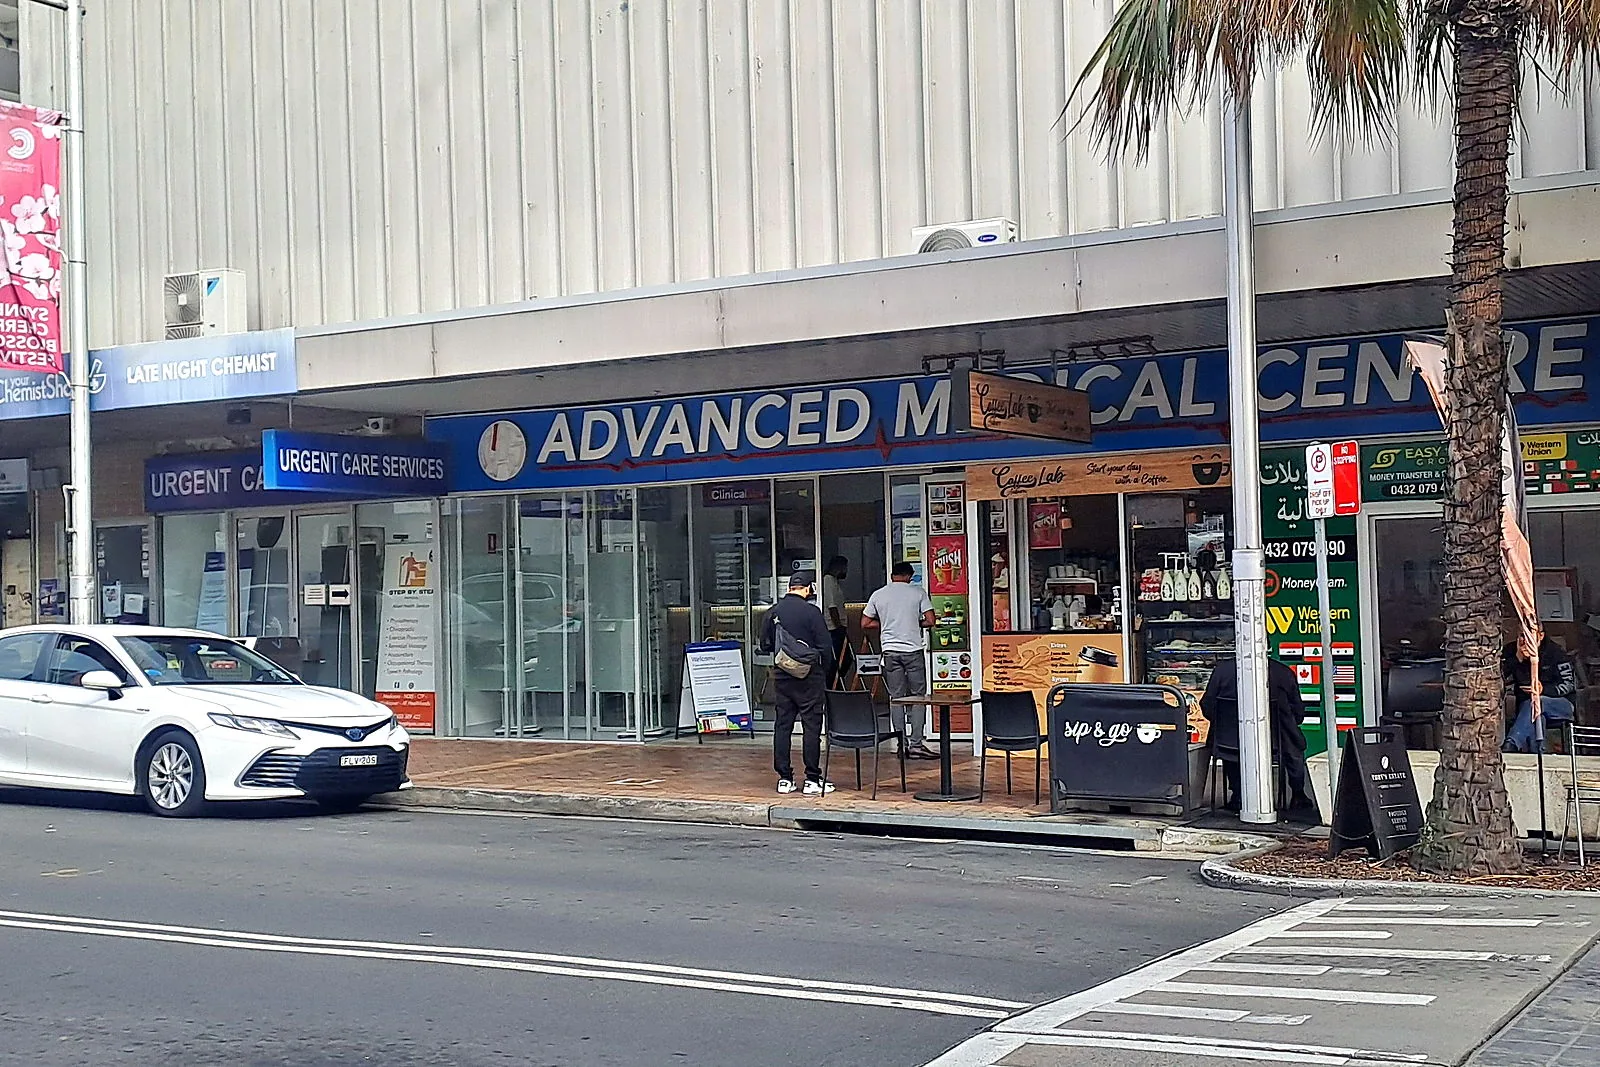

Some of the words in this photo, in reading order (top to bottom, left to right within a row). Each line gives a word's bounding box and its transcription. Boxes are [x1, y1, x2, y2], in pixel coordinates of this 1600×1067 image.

[126, 363, 160, 384] LATE
[163, 359, 209, 381] NIGHT
[211, 352, 277, 377] CHEMIST
[10, 376, 30, 388] your
[537, 388, 870, 463] ADVANCED
[894, 358, 1215, 438] MCAL
[1256, 324, 1588, 412] CENRE
[1527, 440, 1561, 449] Western
[1333, 455, 1357, 465] STOPPING
[1405, 446, 1442, 459] EASY
[279, 448, 338, 474] URGENT
[341, 453, 379, 475] CARE
[382, 455, 444, 480] SERVICES
[1107, 465, 1126, 476] your
[1127, 462, 1142, 473] day
[151, 468, 231, 497] URGENT
[992, 466, 1037, 489] Coffee
[1037, 466, 1068, 487] Lab
[1369, 473, 1395, 482] MONEY
[1396, 470, 1433, 480] TRANSFER
[711, 489, 747, 500] Clinical
[1391, 484, 1416, 495] 0432
[1418, 483, 1438, 494] 079
[1262, 541, 1289, 557] 432
[1292, 541, 1316, 557] 079
[1325, 540, 1346, 556] 90
[1297, 606, 1351, 620] Weern
[1064, 720, 1092, 744] sip
[1093, 721, 1106, 738] &
[1099, 722, 1133, 747] go
